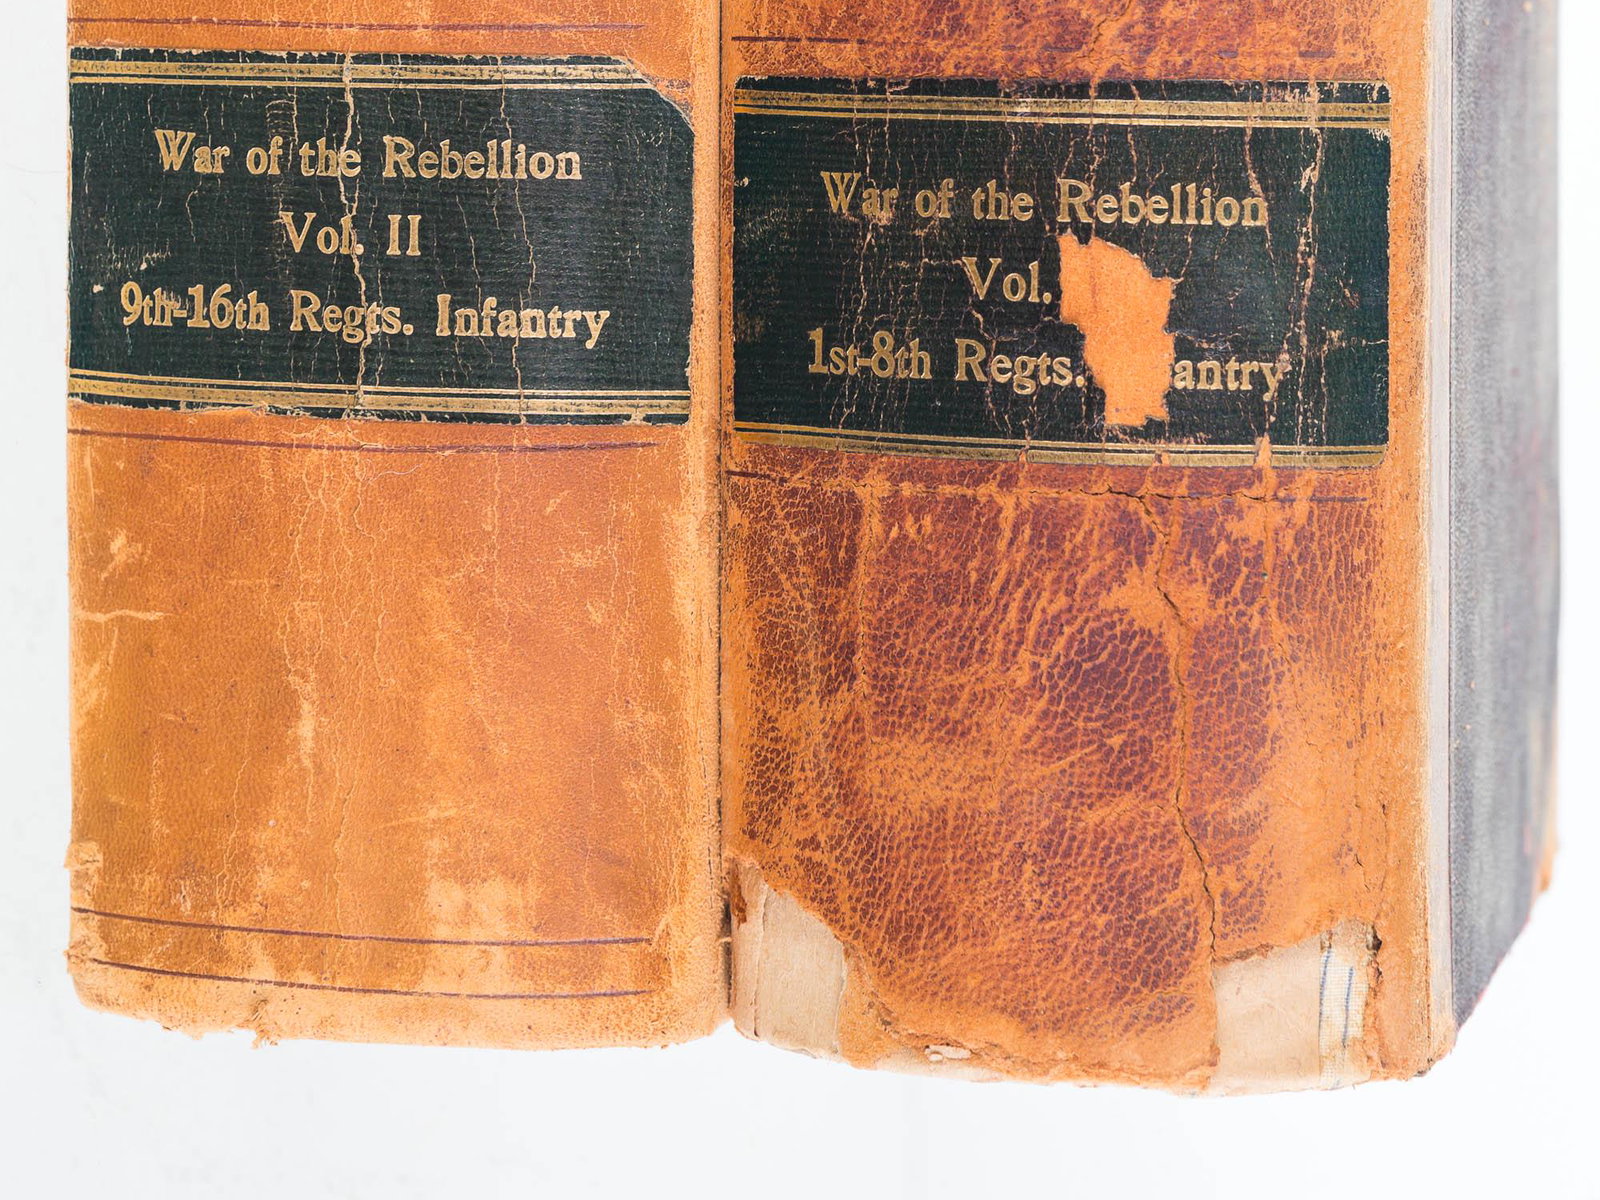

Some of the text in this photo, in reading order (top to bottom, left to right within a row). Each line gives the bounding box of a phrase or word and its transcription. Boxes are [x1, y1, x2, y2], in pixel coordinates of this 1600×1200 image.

[154, 128, 583, 180] War of the Rebellion
[820, 171, 1269, 227] War of the Rebellion
[279, 211, 423, 256] Vol. II
[962, 256, 1052, 303] Vol.
[120, 280, 611, 350] 9th-16th Regts. Infantry
[807, 327, 1285, 401] 1st-8th Regts. antry
